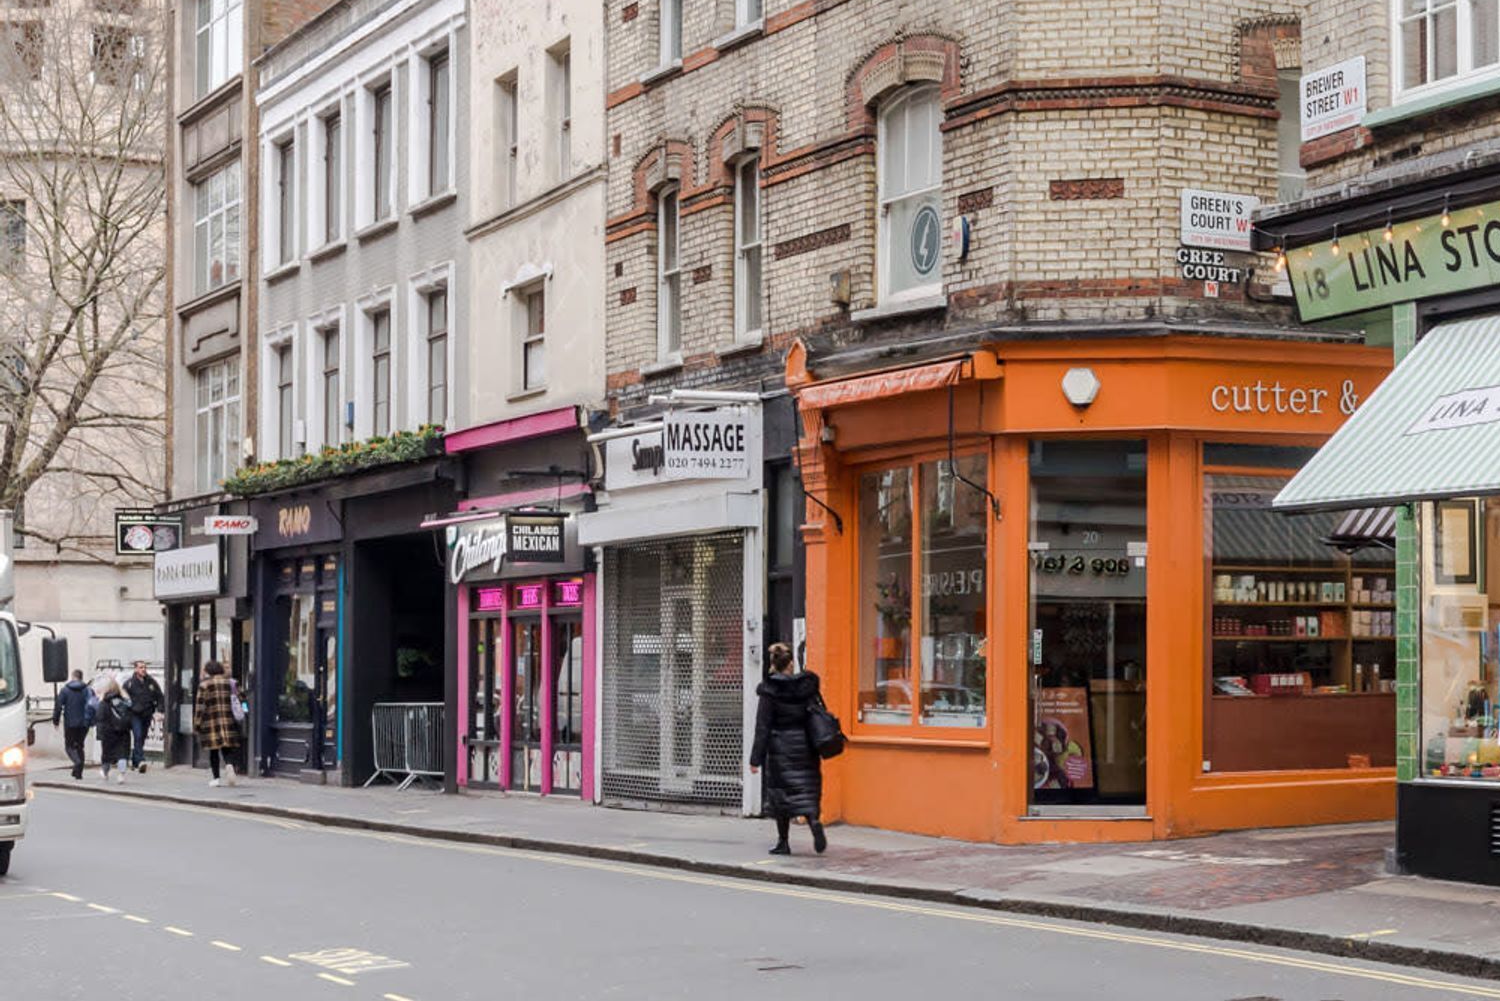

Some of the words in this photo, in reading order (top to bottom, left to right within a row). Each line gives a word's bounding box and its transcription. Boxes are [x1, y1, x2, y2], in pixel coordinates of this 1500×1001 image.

[1306, 71, 1344, 98] BREWER
[1306, 92, 1340, 118] STREET
[1344, 87, 1358, 105] W1
[1191, 195, 1243, 215] GREEN'S
[1191, 213, 1232, 230] COURT
[1236, 218, 1252, 232] W
[1177, 249, 1224, 266] GREE
[1183, 265, 1240, 283] COURT
[1303, 267, 1330, 304] 18
[1348, 238, 1426, 292] LINA
[1211, 380, 1328, 414] cutter
[1339, 379, 1359, 414] &
[1429, 397, 1489, 422] LINA
[667, 423, 745, 452] MASSAGE
[668, 458, 688, 468] 020
[720, 458, 745, 468] 2277
[213, 520, 250, 529] RAMO
[279, 505, 312, 537] RAMO
[512, 536, 560, 551] MEXICAN
